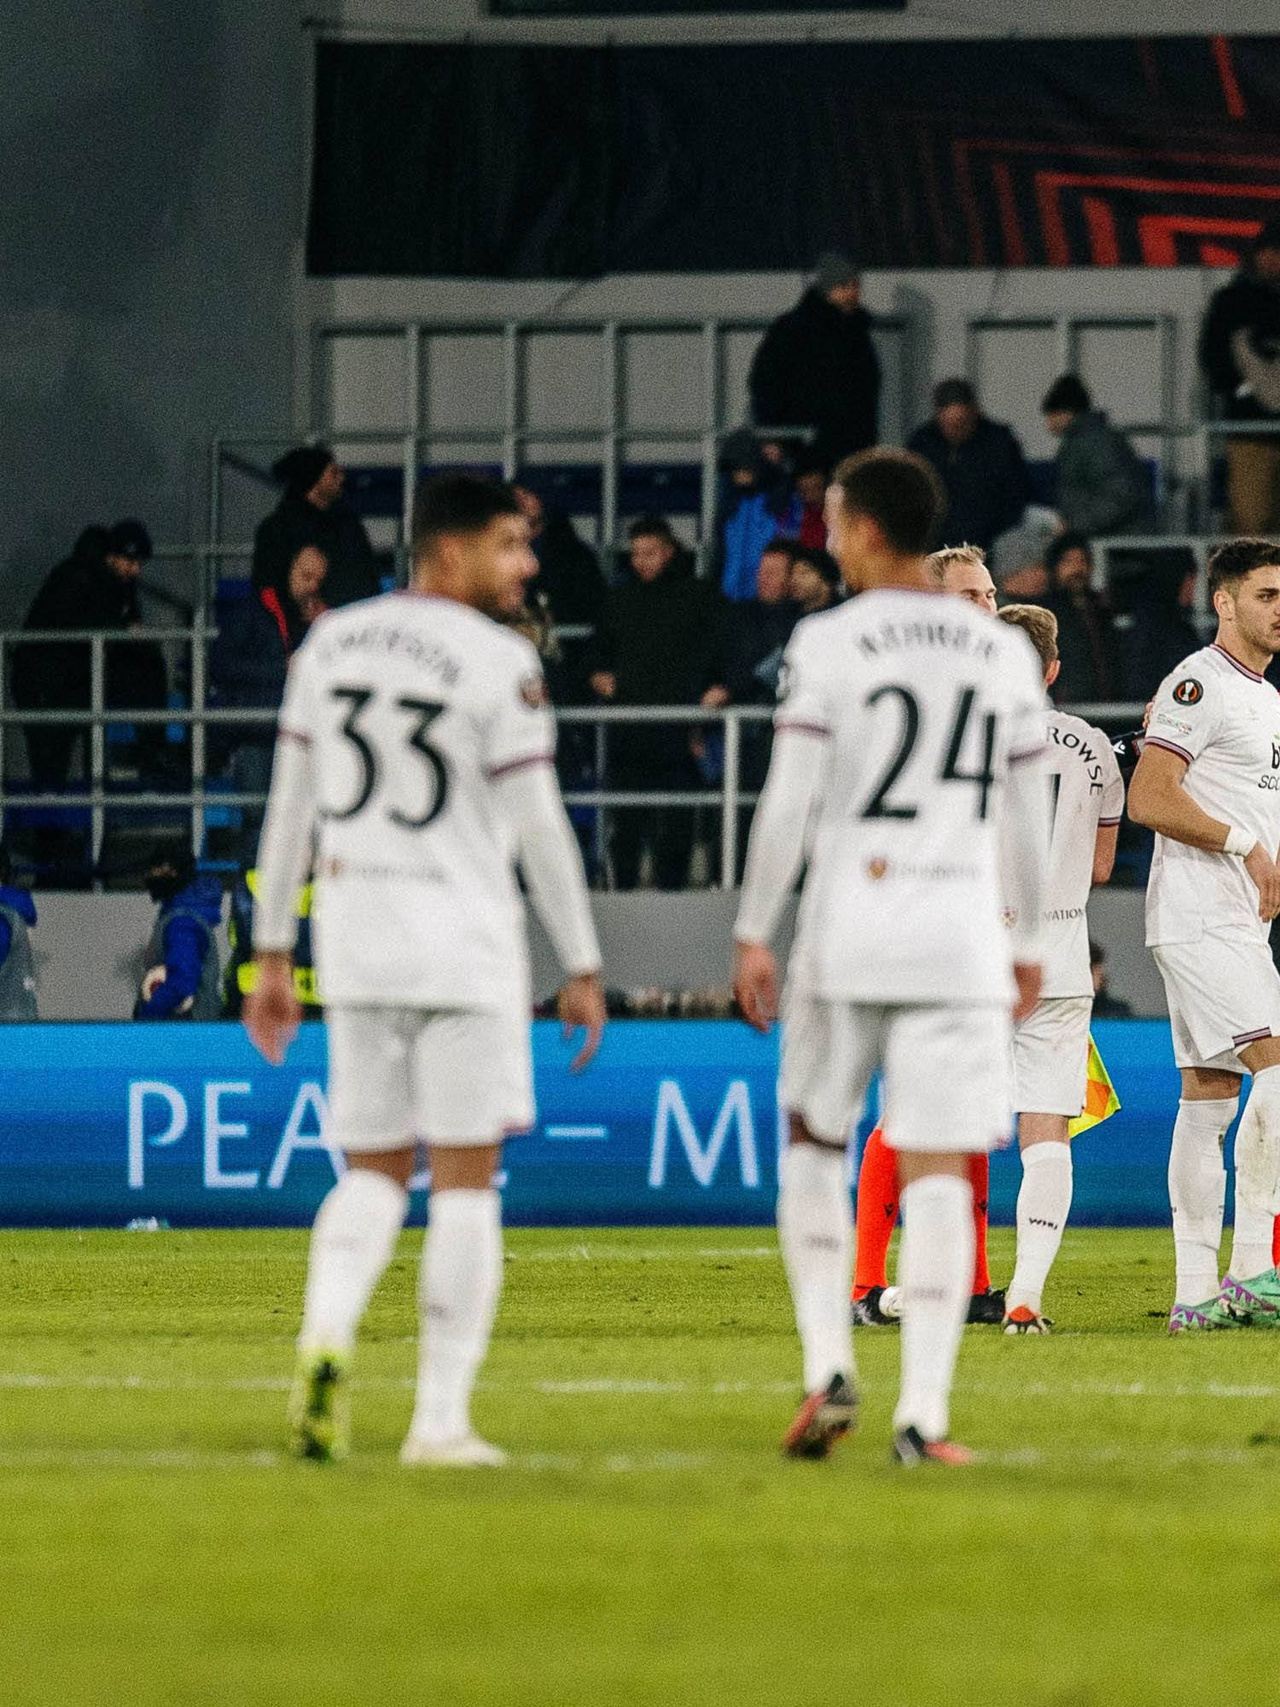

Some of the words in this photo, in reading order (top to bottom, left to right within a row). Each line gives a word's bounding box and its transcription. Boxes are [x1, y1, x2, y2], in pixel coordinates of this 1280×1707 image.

[320, 681, 450, 831] 33
[858, 684, 998, 822] 24
[127, 1079, 509, 1189] PEA
